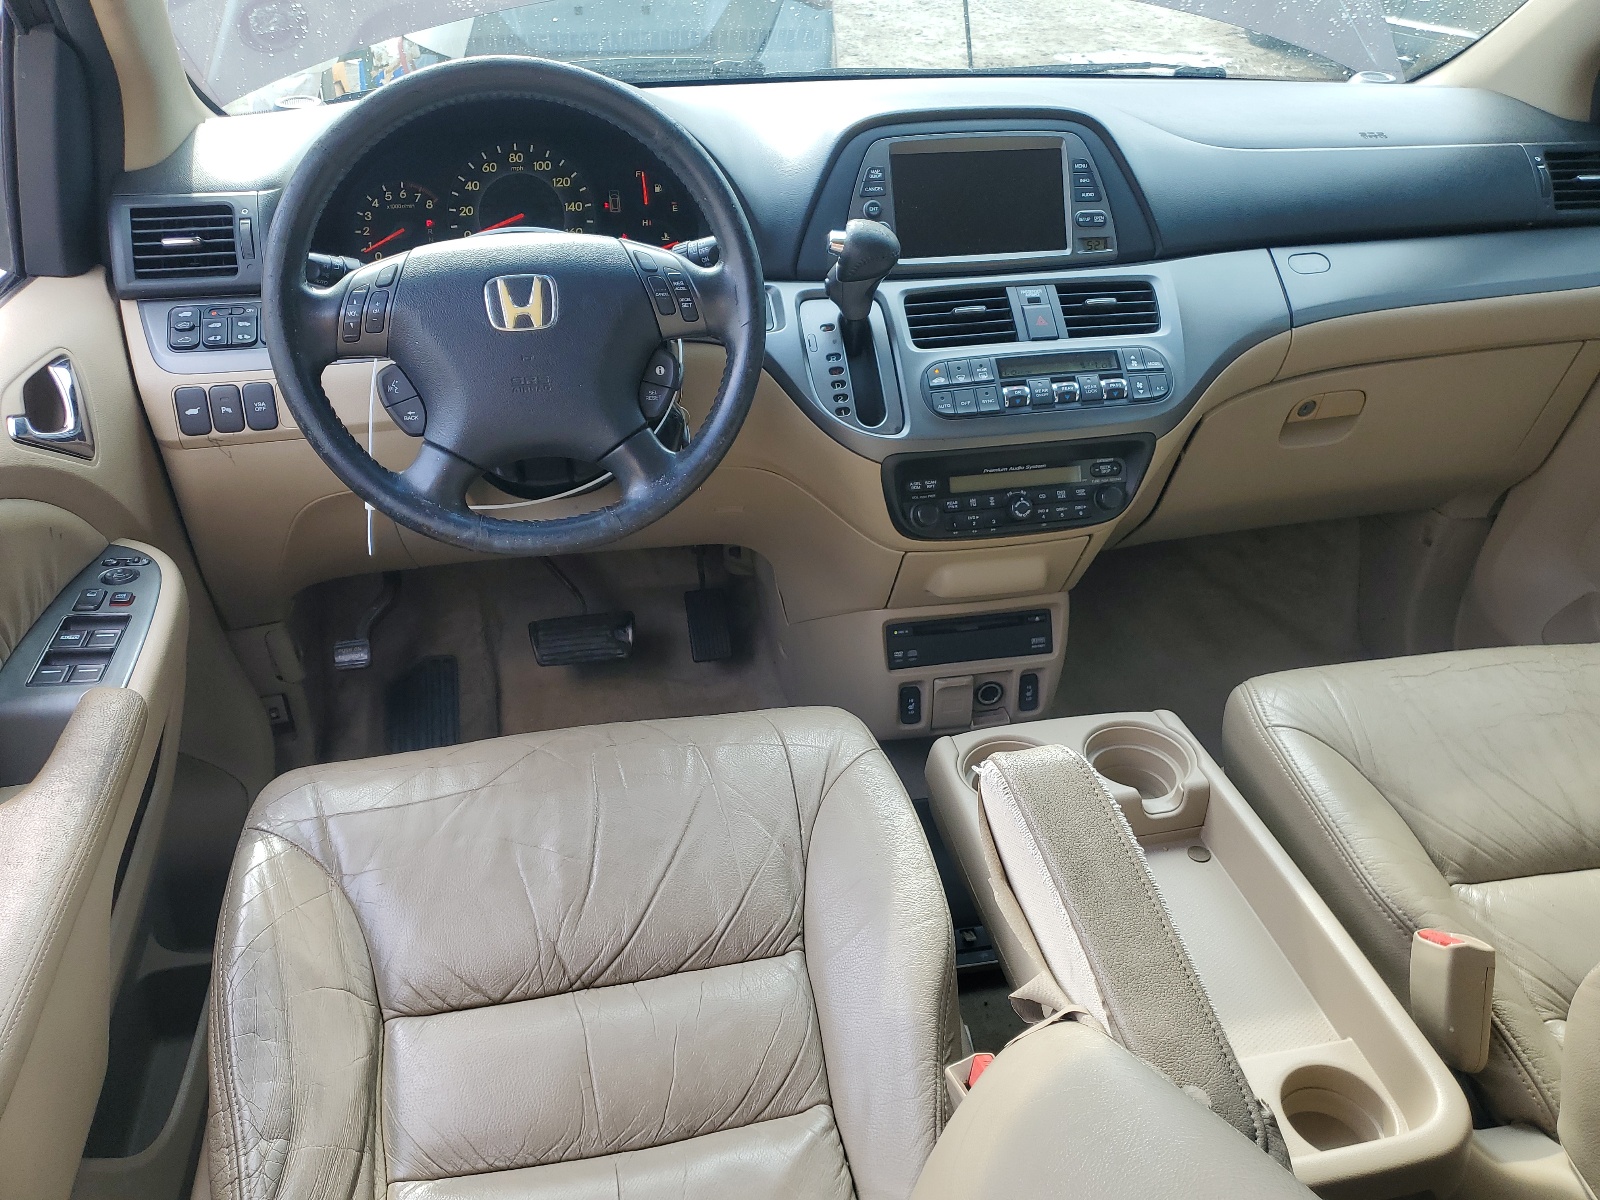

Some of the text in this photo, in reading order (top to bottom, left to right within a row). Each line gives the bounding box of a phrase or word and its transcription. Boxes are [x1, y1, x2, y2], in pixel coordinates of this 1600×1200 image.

[508, 152, 524, 163] 80
[481, 162, 497, 173] 60
[510, 165, 524, 173] mph
[533, 160, 552, 171] 100
[635, 170, 641, 178] F
[464, 181, 480, 191] 40
[552, 177, 571, 188] 120
[384, 191, 393, 201] 5
[399, 189, 407, 199] 6
[414, 193, 422, 203] 7
[371, 198, 379, 208] 4
[425, 199, 434, 209] 8
[564, 201, 583, 212] 140
[672, 204, 679, 212] E
[364, 211, 372, 221] 3
[459, 206, 474, 216] 20
[425, 219, 434, 227] P
[642, 219, 649, 227] H
[362, 226, 371, 236] 2
[374, 251, 383, 261] 0
[834, 382, 842, 390] D
[837, 395, 844, 403] 2
